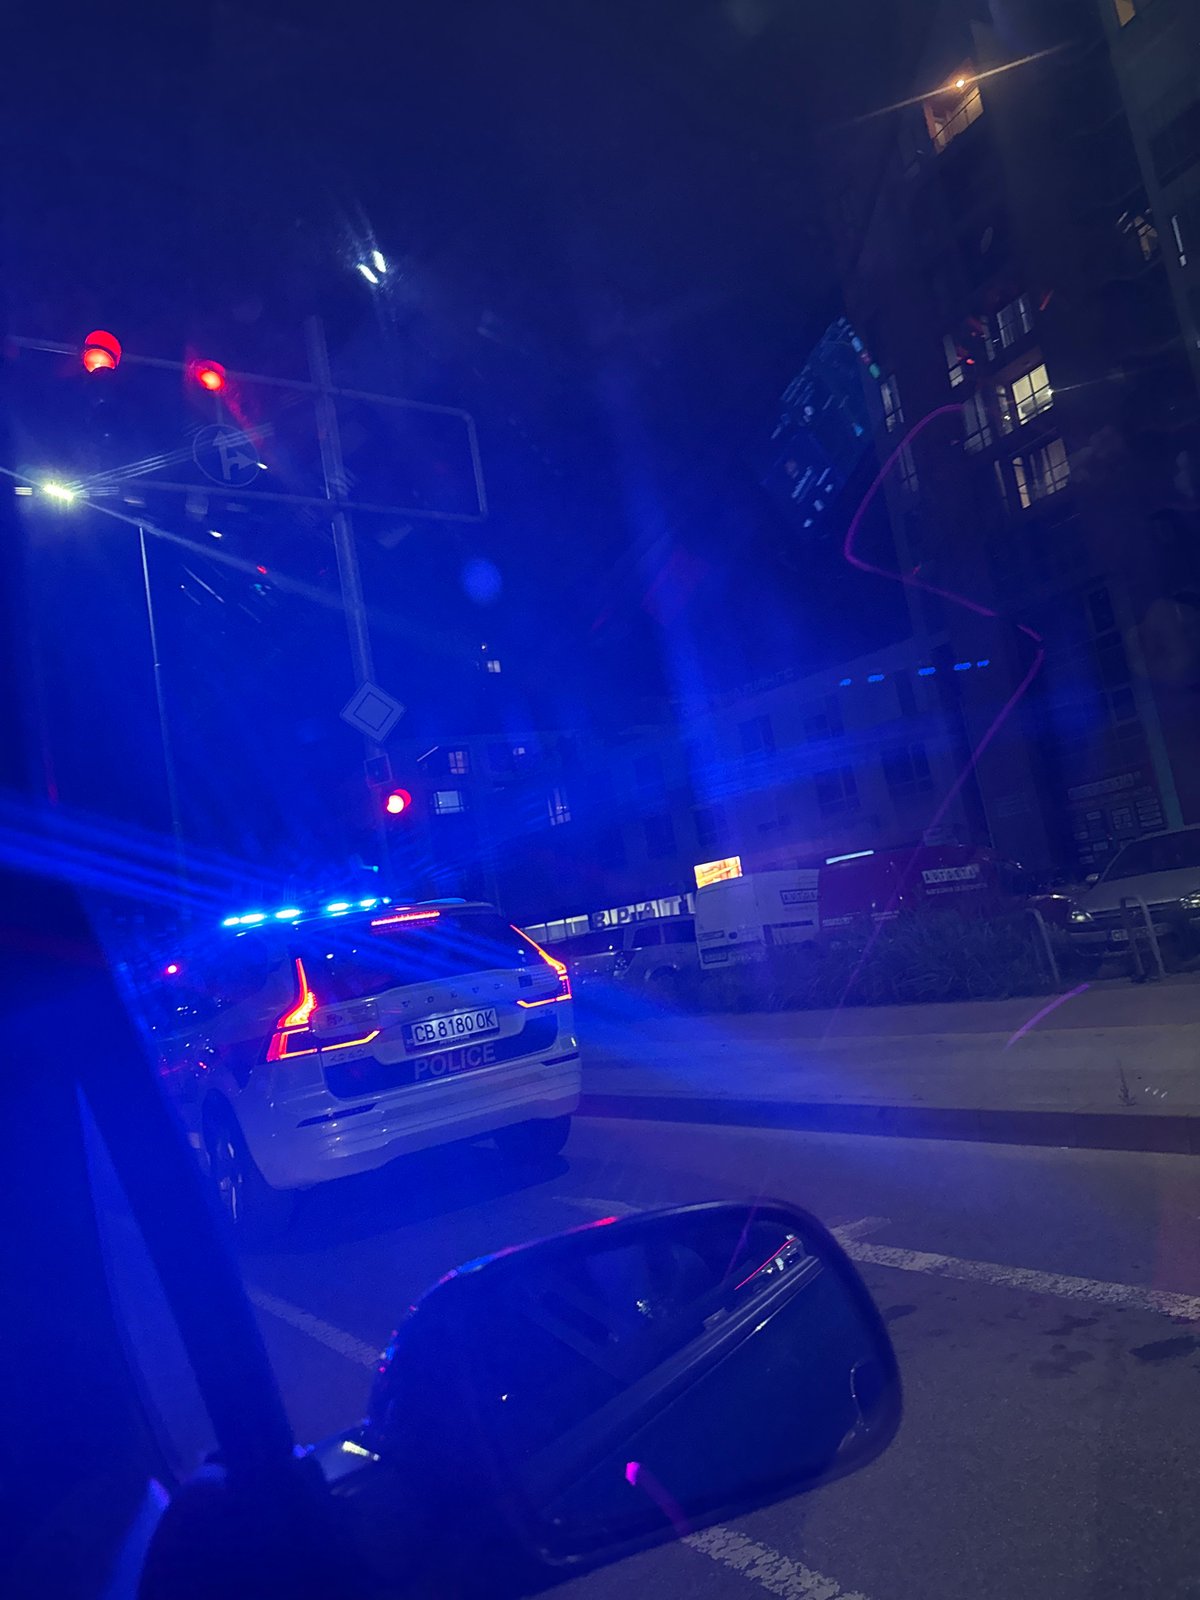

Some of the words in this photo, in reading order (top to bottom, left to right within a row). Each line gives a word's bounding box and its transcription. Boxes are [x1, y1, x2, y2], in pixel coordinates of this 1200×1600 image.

[402, 983, 502, 1008] VOLVO
[414, 1023, 436, 1042] CB
[438, 1015, 474, 1037] 8180
[475, 1010, 495, 1028] OK
[415, 1043, 496, 1080] POLICE
